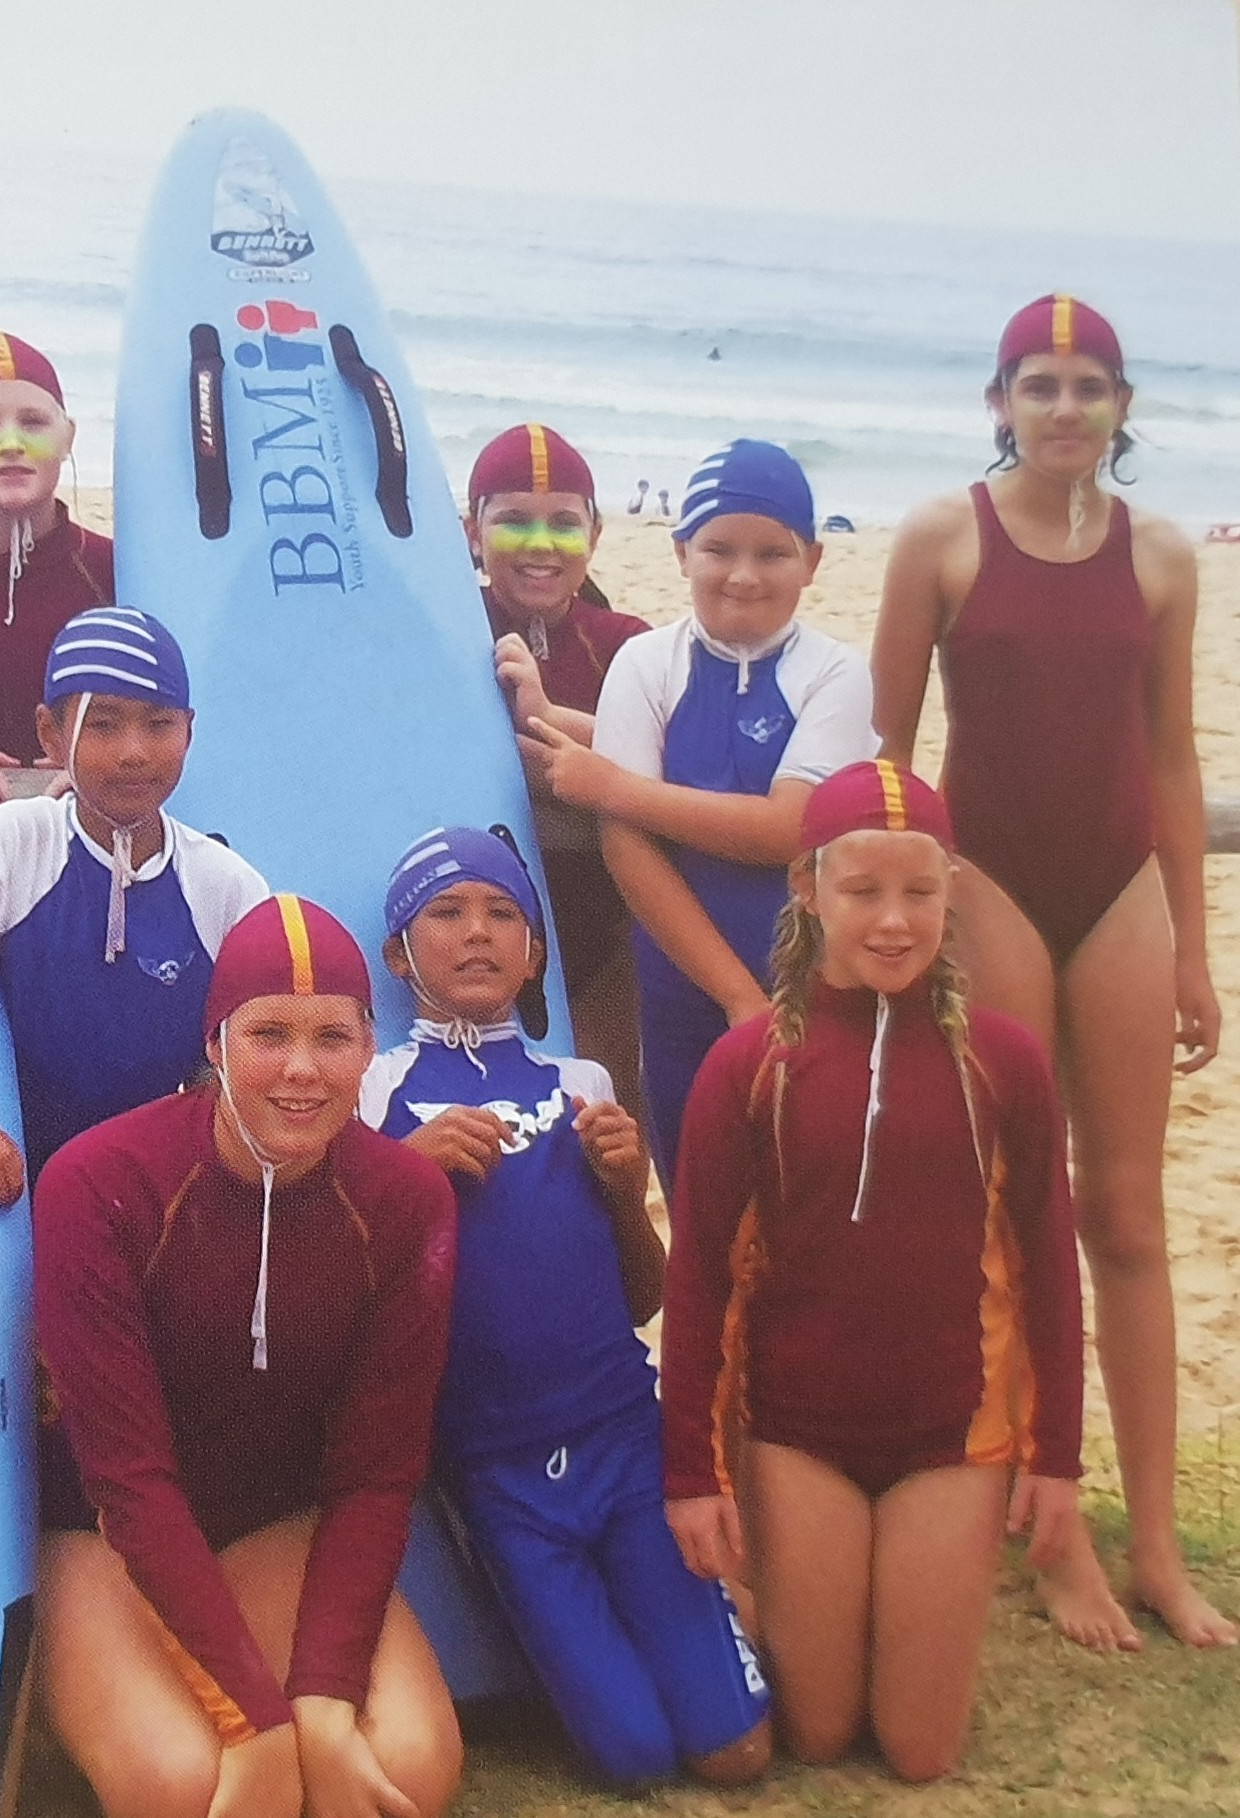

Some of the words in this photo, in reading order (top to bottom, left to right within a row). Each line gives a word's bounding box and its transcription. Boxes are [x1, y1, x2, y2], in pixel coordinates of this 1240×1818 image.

[327, 422, 345, 463] Since
[238, 377, 346, 597] BBM
[335, 466, 359, 533] Support
[344, 540, 365, 592] Youth
